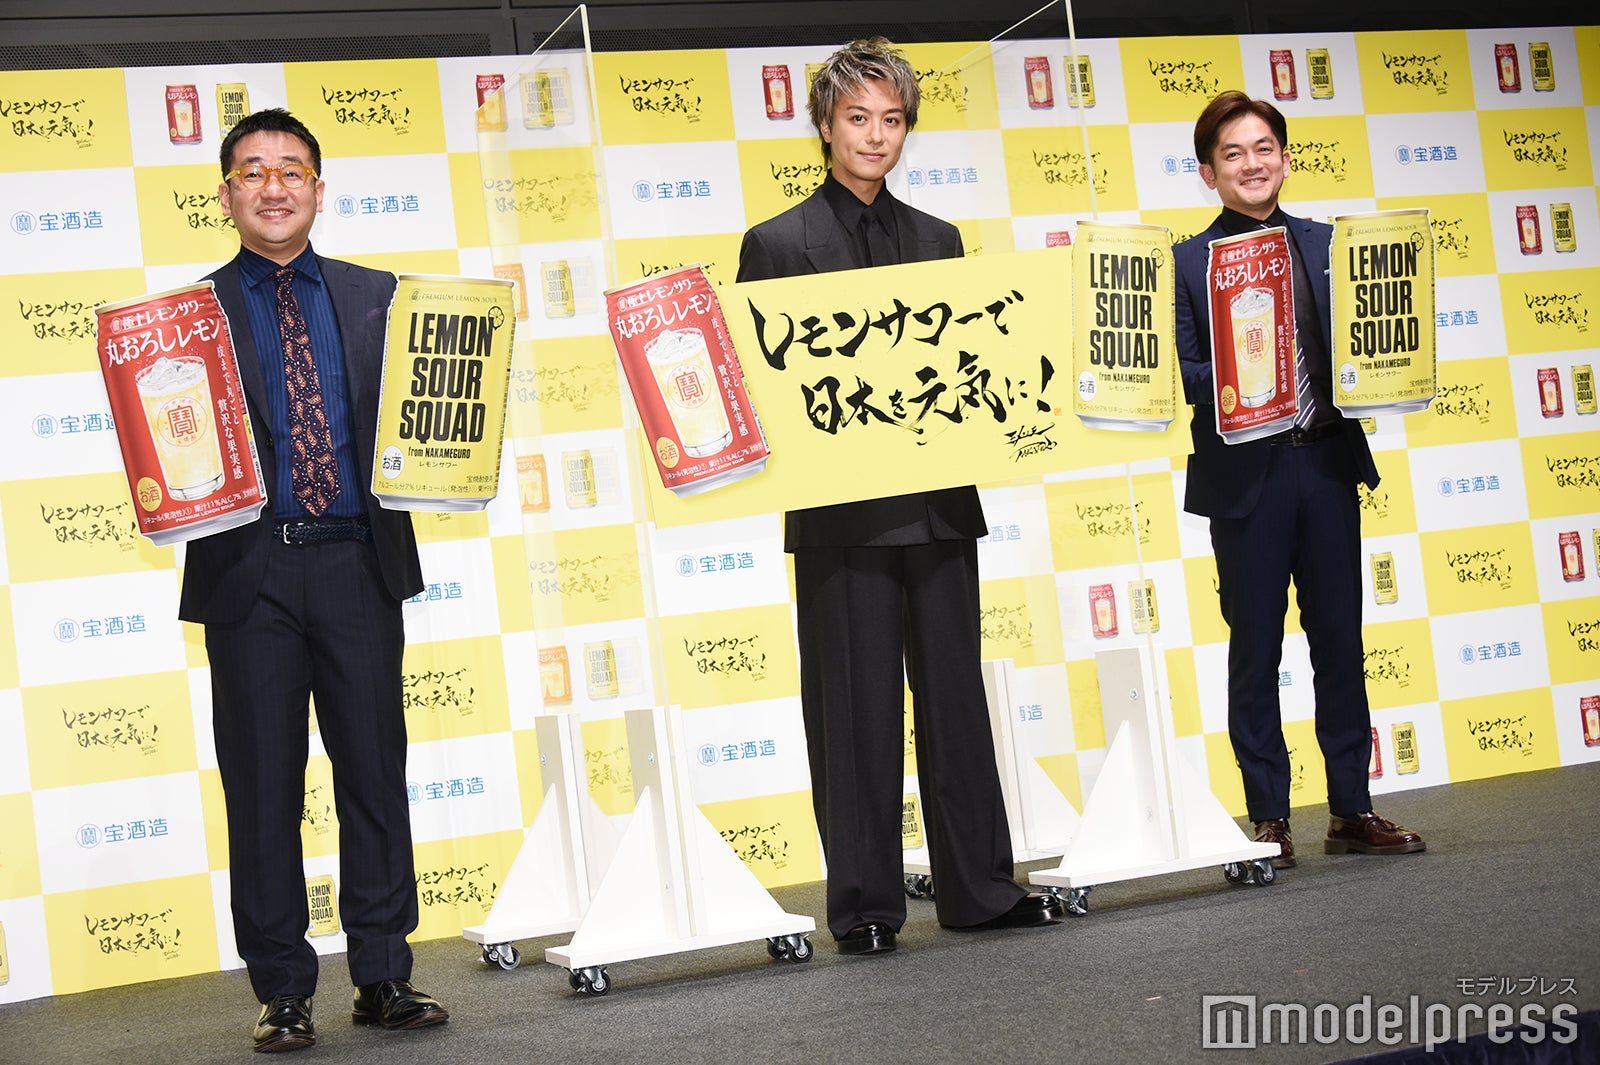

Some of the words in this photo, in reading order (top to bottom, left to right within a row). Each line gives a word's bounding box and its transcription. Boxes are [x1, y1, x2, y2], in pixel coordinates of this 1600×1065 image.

[1148, 57, 1212, 74] レモンサワーで
[1382, 52, 1441, 68] レモンサワーで
[620, 75, 694, 93] レモンサワーで
[0, 99, 85, 117] レモンサワーで
[1504, 130, 1561, 145] レモンサワーで
[1414, 145, 1457, 162] 宝酒造
[929, 168, 978, 185] 宝酒造
[657, 181, 711, 199] 宝酒造
[360, 193, 420, 214] 宝酒造
[39, 210, 104, 231] 宝酒造
[1349, 242, 1417, 281] LEMON
[1090, 253, 1157, 293] LEMON
[1214, 257, 1287, 292] 丸おろしレモン
[1355, 280, 1412, 319] SOUR
[1524, 293, 1582, 308] レモンサワーで
[615, 293, 712, 341] 丸おろしレモン
[1096, 292, 1152, 330] SOUR
[1436, 311, 1478, 327] 宝酒造
[408, 312, 495, 357] LEMON
[747, 289, 1024, 371] レモンサワーで
[1350, 316, 1419, 359] SQUAD
[105, 318, 220, 367] 丸おろしレモン
[1090, 330, 1158, 369] SQUAD
[1360, 362, 1372, 370] from
[1374, 357, 1411, 369] NAKAMEGURO
[411, 357, 483, 399] SOUR
[1079, 381, 1095, 393] お酒
[1099, 372, 1112, 381] from
[1113, 373, 1150, 384] NAKAMEGURO
[1340, 371, 1356, 384] お酒
[801, 350, 1055, 445] 日本を元気に!
[399, 399, 486, 444] SQUAD
[408, 446, 424, 457] from
[425, 447, 471, 459] NAKAMEGURO
[659, 445, 678, 461] お酒
[382, 455, 402, 471] お酒
[140, 485, 160, 503] お酒
[1457, 475, 1500, 493] 宝酒造
[40, 502, 128, 524] レモンサワーで
[700, 552, 753, 573] 宝酒造
[1447, 549, 1505, 566] レモンサワーで
[83, 614, 146, 638] 宝酒造
[684, 635, 758, 655] レモンサワーで
[1478, 641, 1521, 661] 宝酒造
[62, 705, 150, 728] レモンサワーで
[1468, 716, 1526, 735] レモンサワーで
[721, 739, 776, 762] 宝酒造
[425, 777, 485, 800] 宝酒造
[104, 818, 169, 844] 宝酒造
[308, 884, 331, 897] LEMON
[311, 897, 330, 909] SOUR
[85, 909, 172, 934] レモンサワーで
[311, 907, 334, 921] SQUAD
